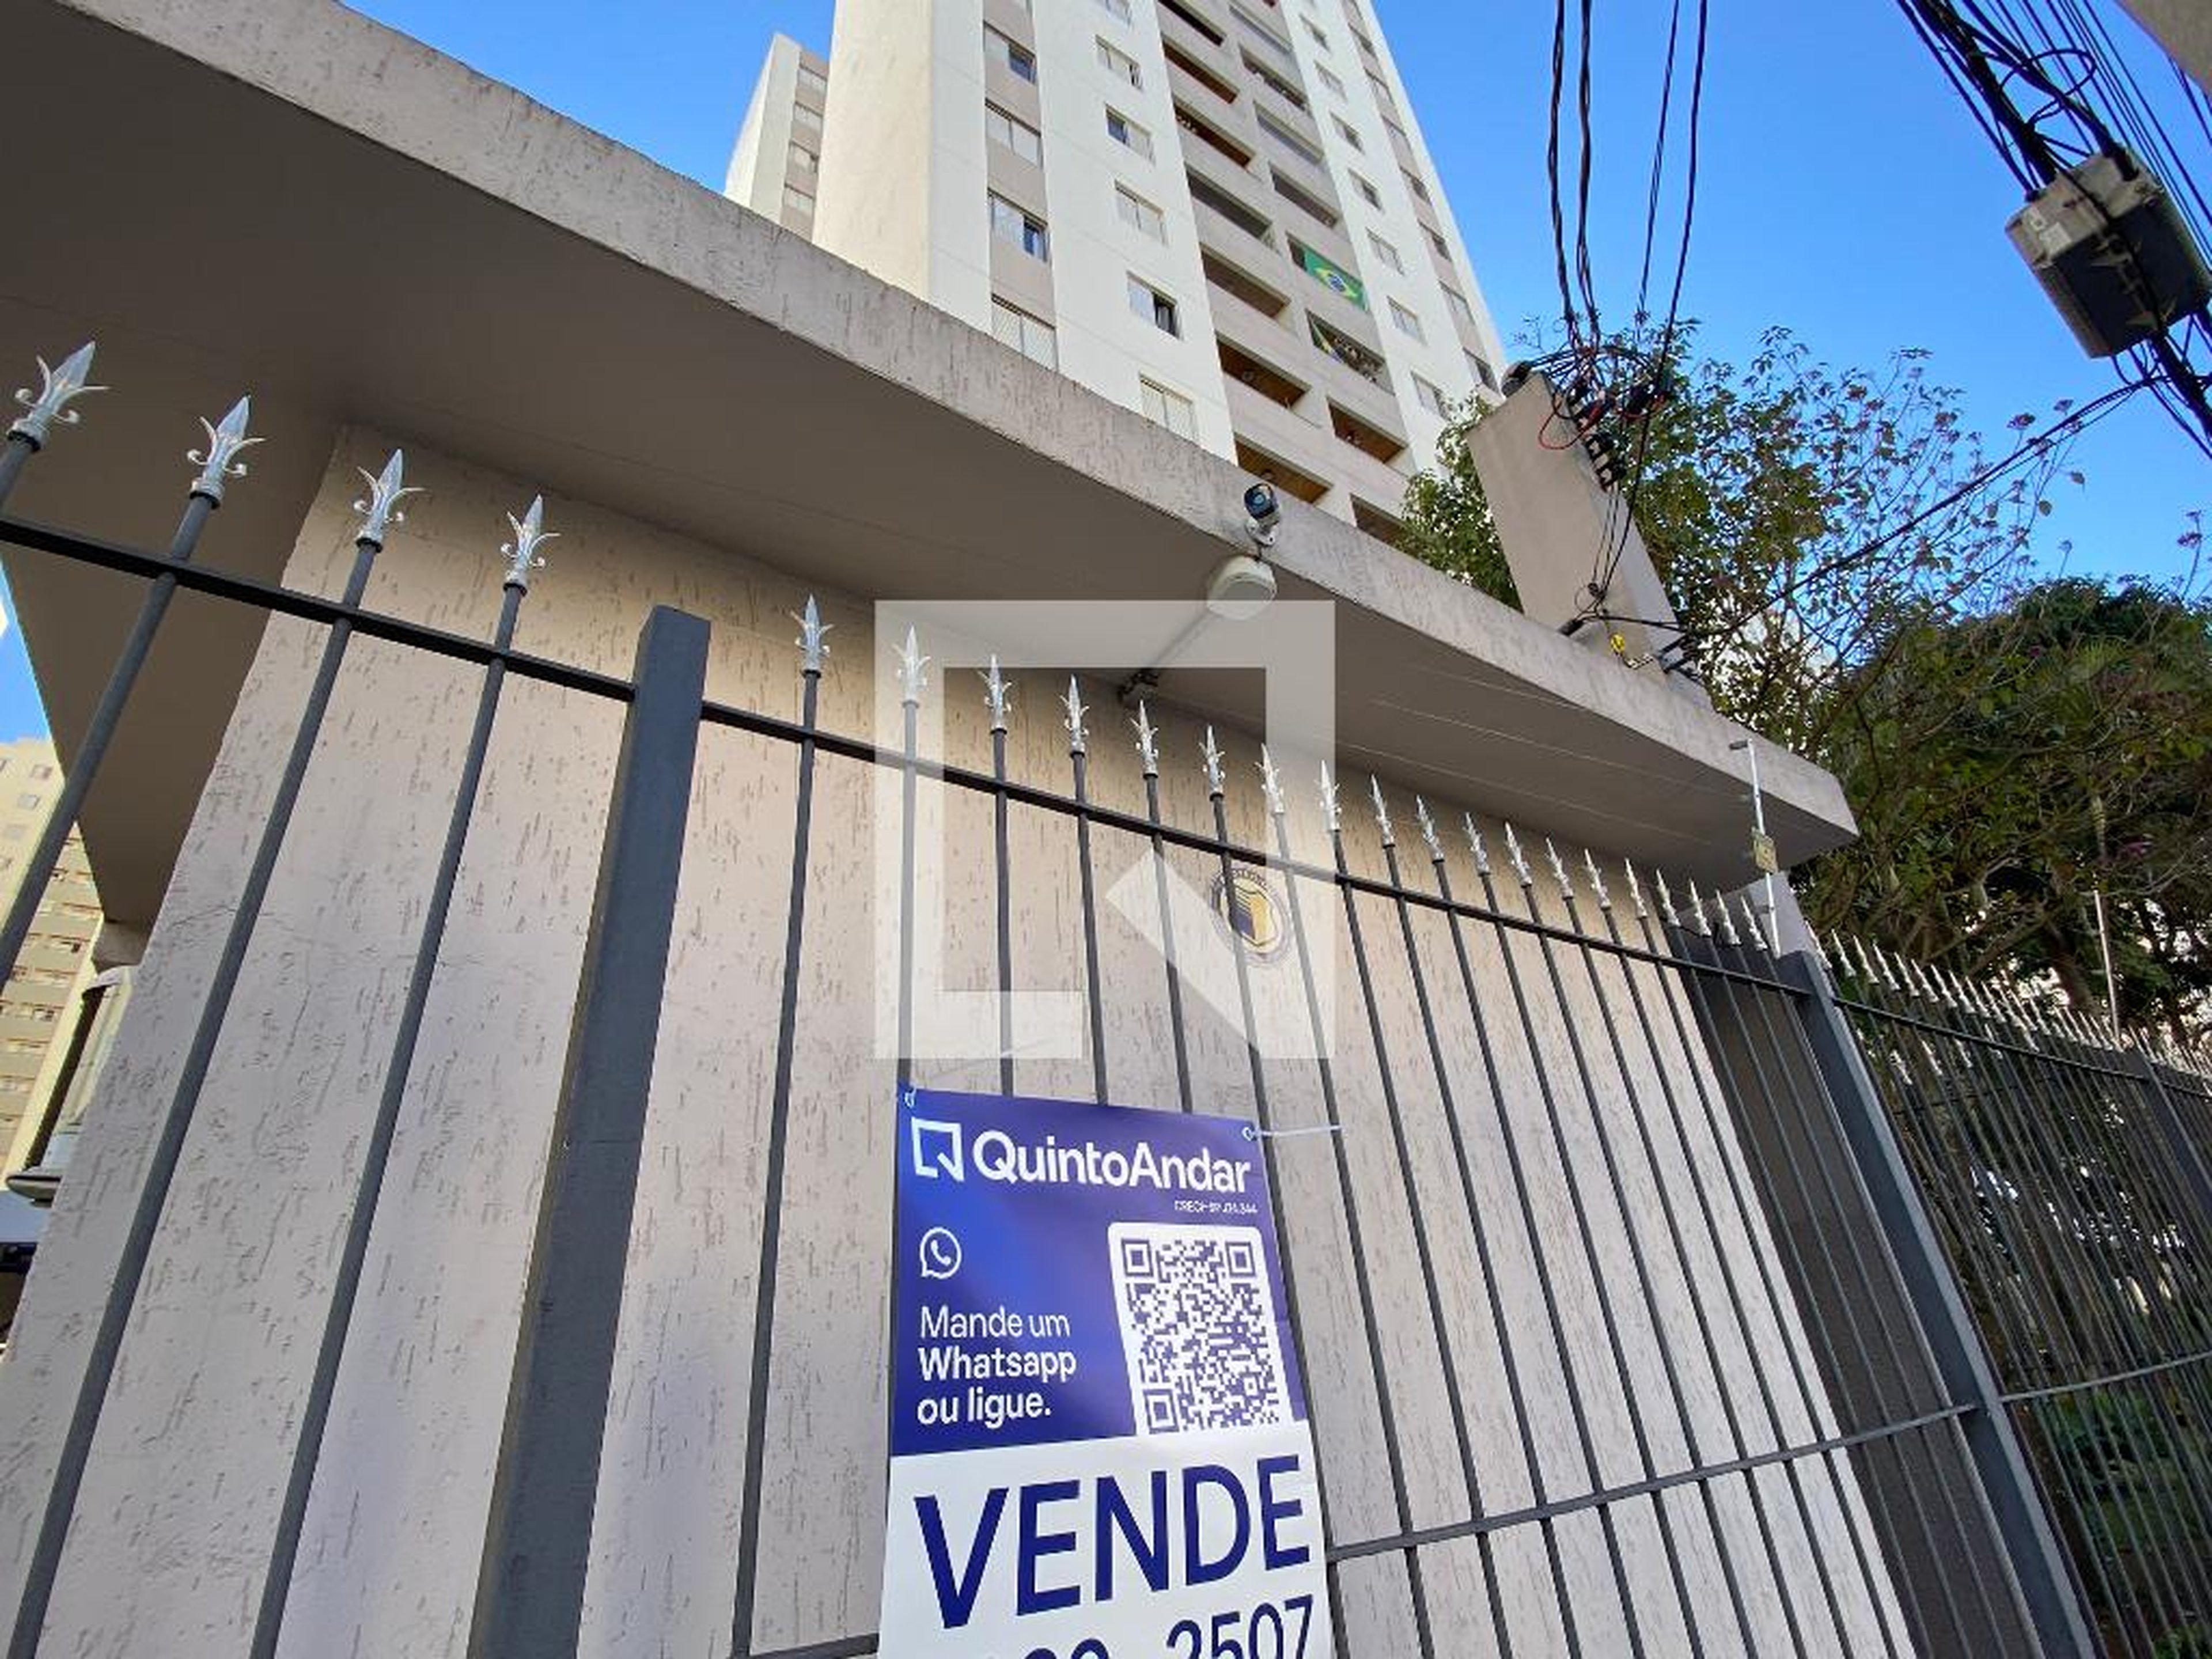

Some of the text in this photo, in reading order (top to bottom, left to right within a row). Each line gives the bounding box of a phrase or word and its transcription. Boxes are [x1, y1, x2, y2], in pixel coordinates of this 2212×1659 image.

[972, 1130, 1252, 1192] QuintoAndar
[921, 1305, 1070, 1338] Mande um
[918, 1345, 1077, 1383] Whatsapp
[917, 1386, 1052, 1429] ou ligue.
[914, 1453, 1310, 1630] VENDE
